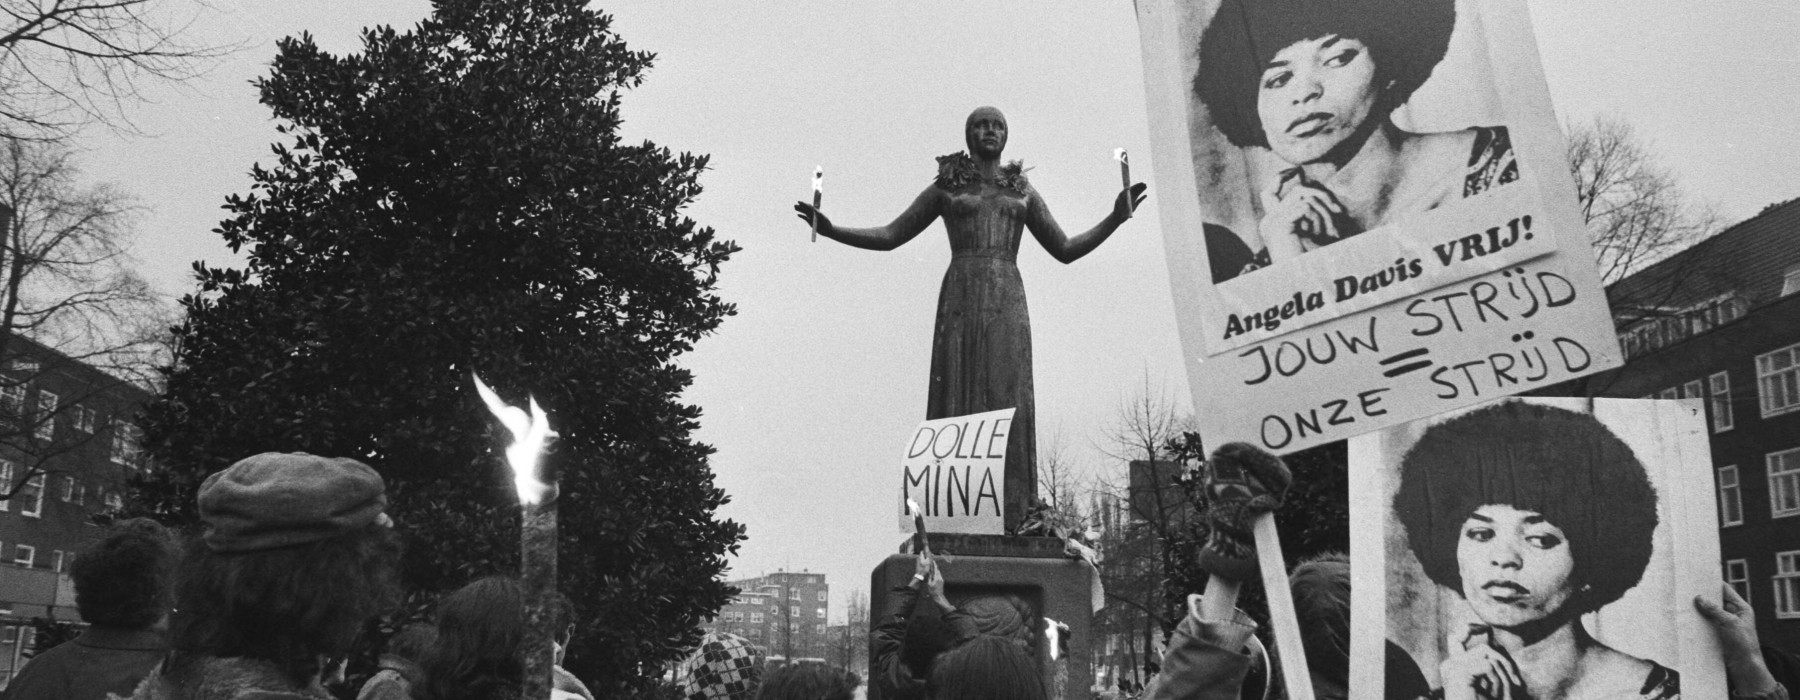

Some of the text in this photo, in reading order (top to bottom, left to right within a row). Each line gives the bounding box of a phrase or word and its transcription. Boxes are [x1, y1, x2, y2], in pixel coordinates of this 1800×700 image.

[1223, 214, 1534, 339] Angela Davis VRIJ!
[1238, 316, 1379, 385] JOUW
[908, 418, 1011, 459] DOLLE
[1261, 388, 1391, 449] ONZE
